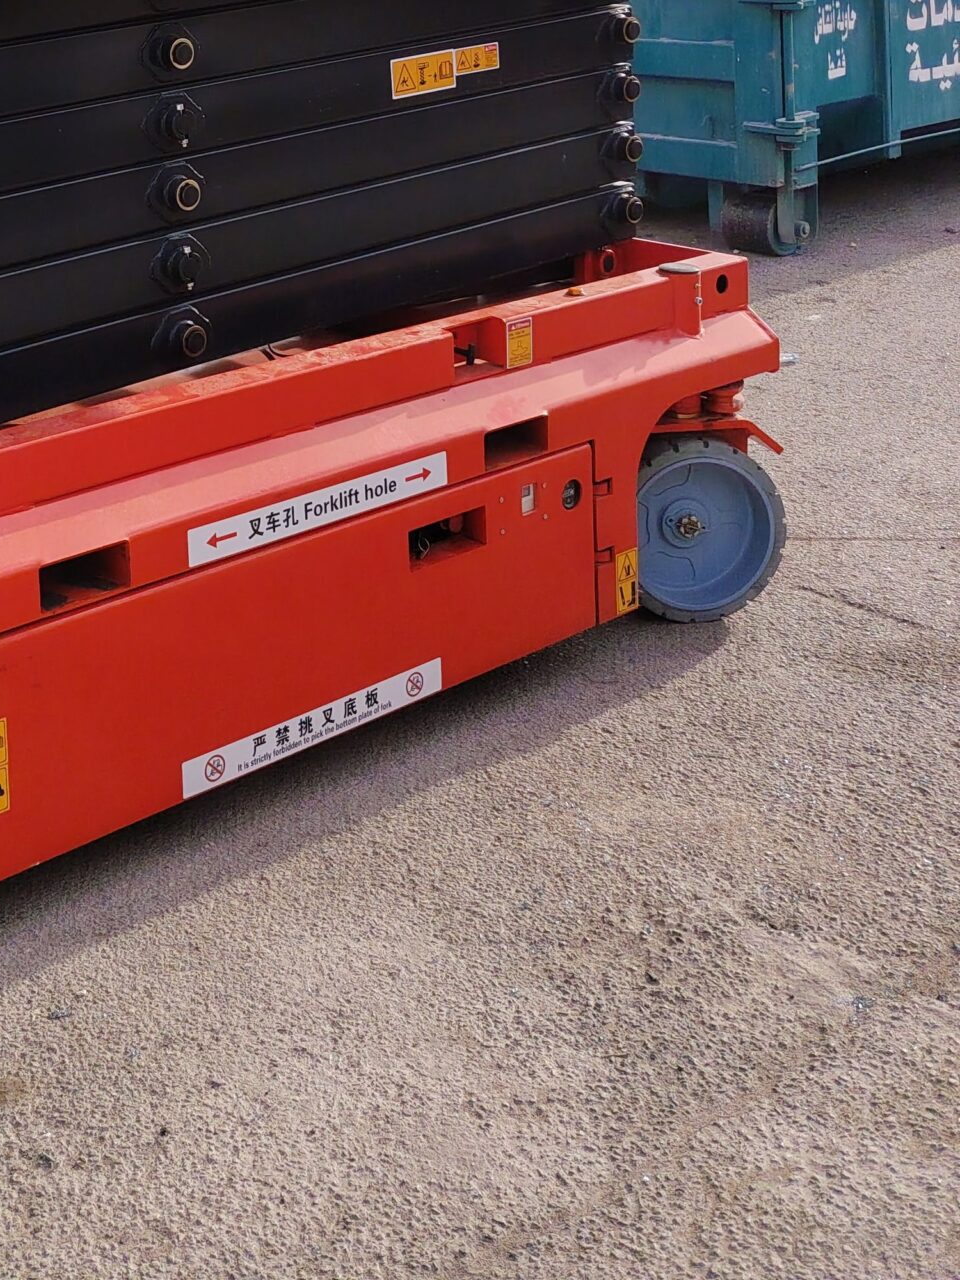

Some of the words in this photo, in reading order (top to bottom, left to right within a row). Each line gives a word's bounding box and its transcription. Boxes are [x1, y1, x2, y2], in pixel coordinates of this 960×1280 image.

[304, 488, 360, 521] Forklift
[365, 478, 397, 501] hole
[248, 506, 299, 540] 叉车孔
[250, 751, 272, 767] strictly
[273, 740, 303, 758] forbidden
[311, 730, 324, 743] pick
[324, 725, 335, 736] the
[335, 717, 358, 731] bottom
[358, 710, 373, 723] plate
[380, 700, 392, 711] fork
